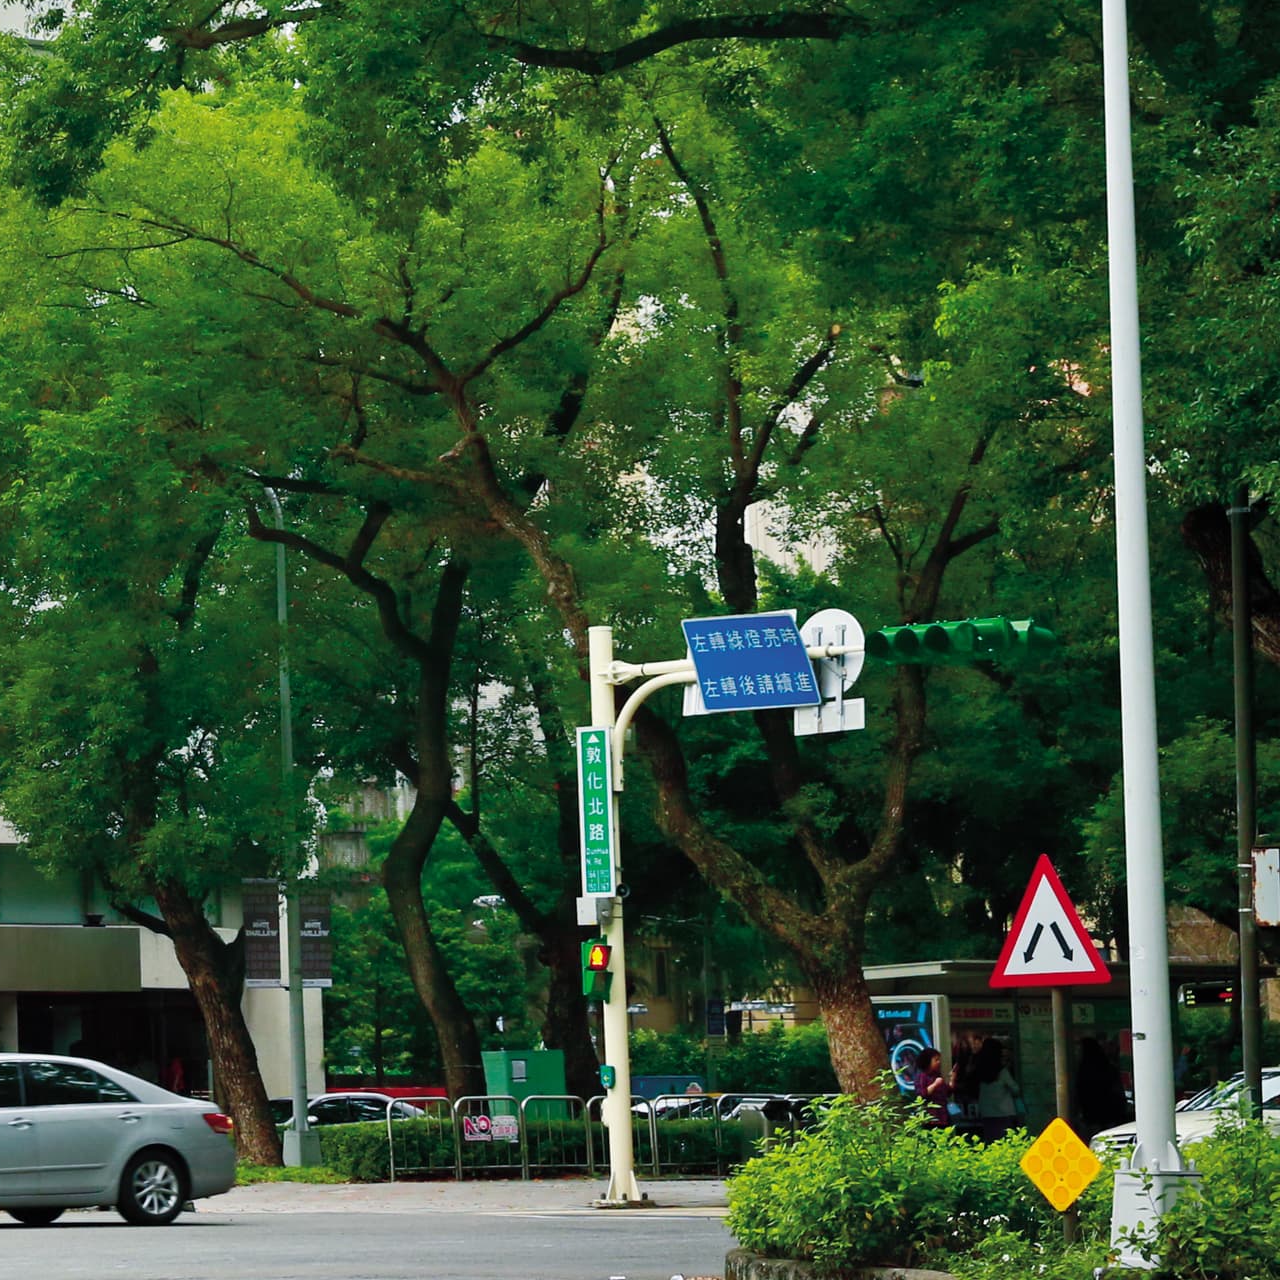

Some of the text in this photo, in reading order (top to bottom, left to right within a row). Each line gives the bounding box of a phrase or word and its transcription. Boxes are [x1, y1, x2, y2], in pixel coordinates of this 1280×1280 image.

[691, 627, 798, 653] 左轉綠燈亮時
[703, 671, 814, 698] 左轉後請續進
[586, 747, 605, 841] 敦化北路
[463, 1115, 492, 1136] NO
